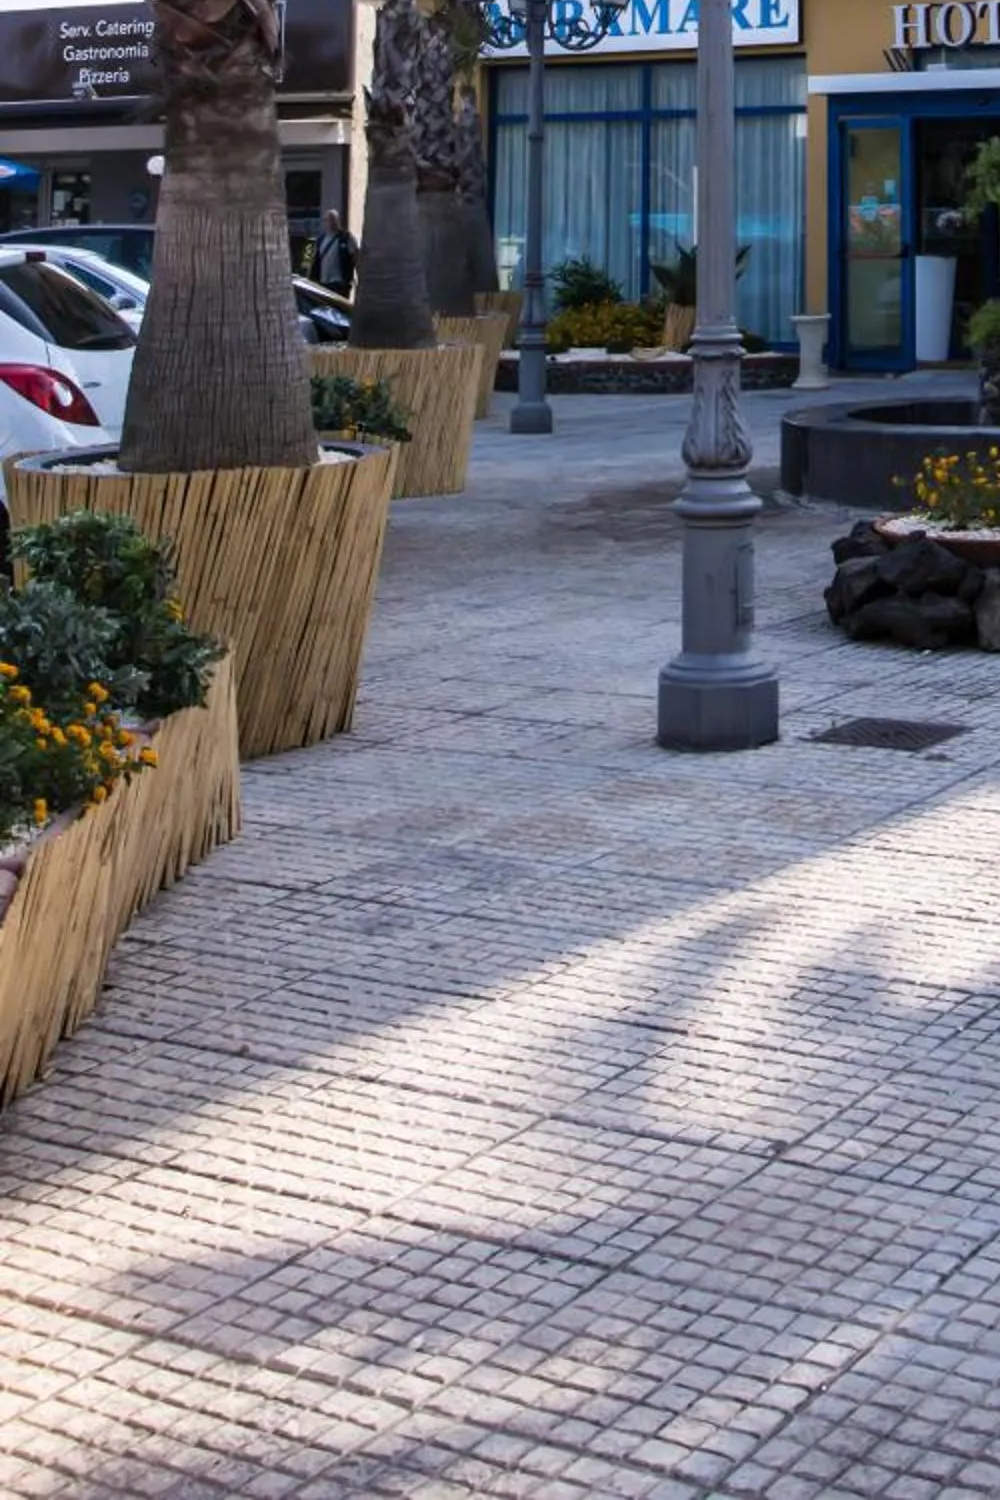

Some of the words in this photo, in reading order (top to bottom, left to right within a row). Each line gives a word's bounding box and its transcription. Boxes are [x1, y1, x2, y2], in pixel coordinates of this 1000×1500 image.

[60, 21, 92, 39] Serv.
[95, 19, 155, 38] Catering
[63, 42, 149, 61] Gastronomia
[79, 67, 130, 85] Pizzeria
